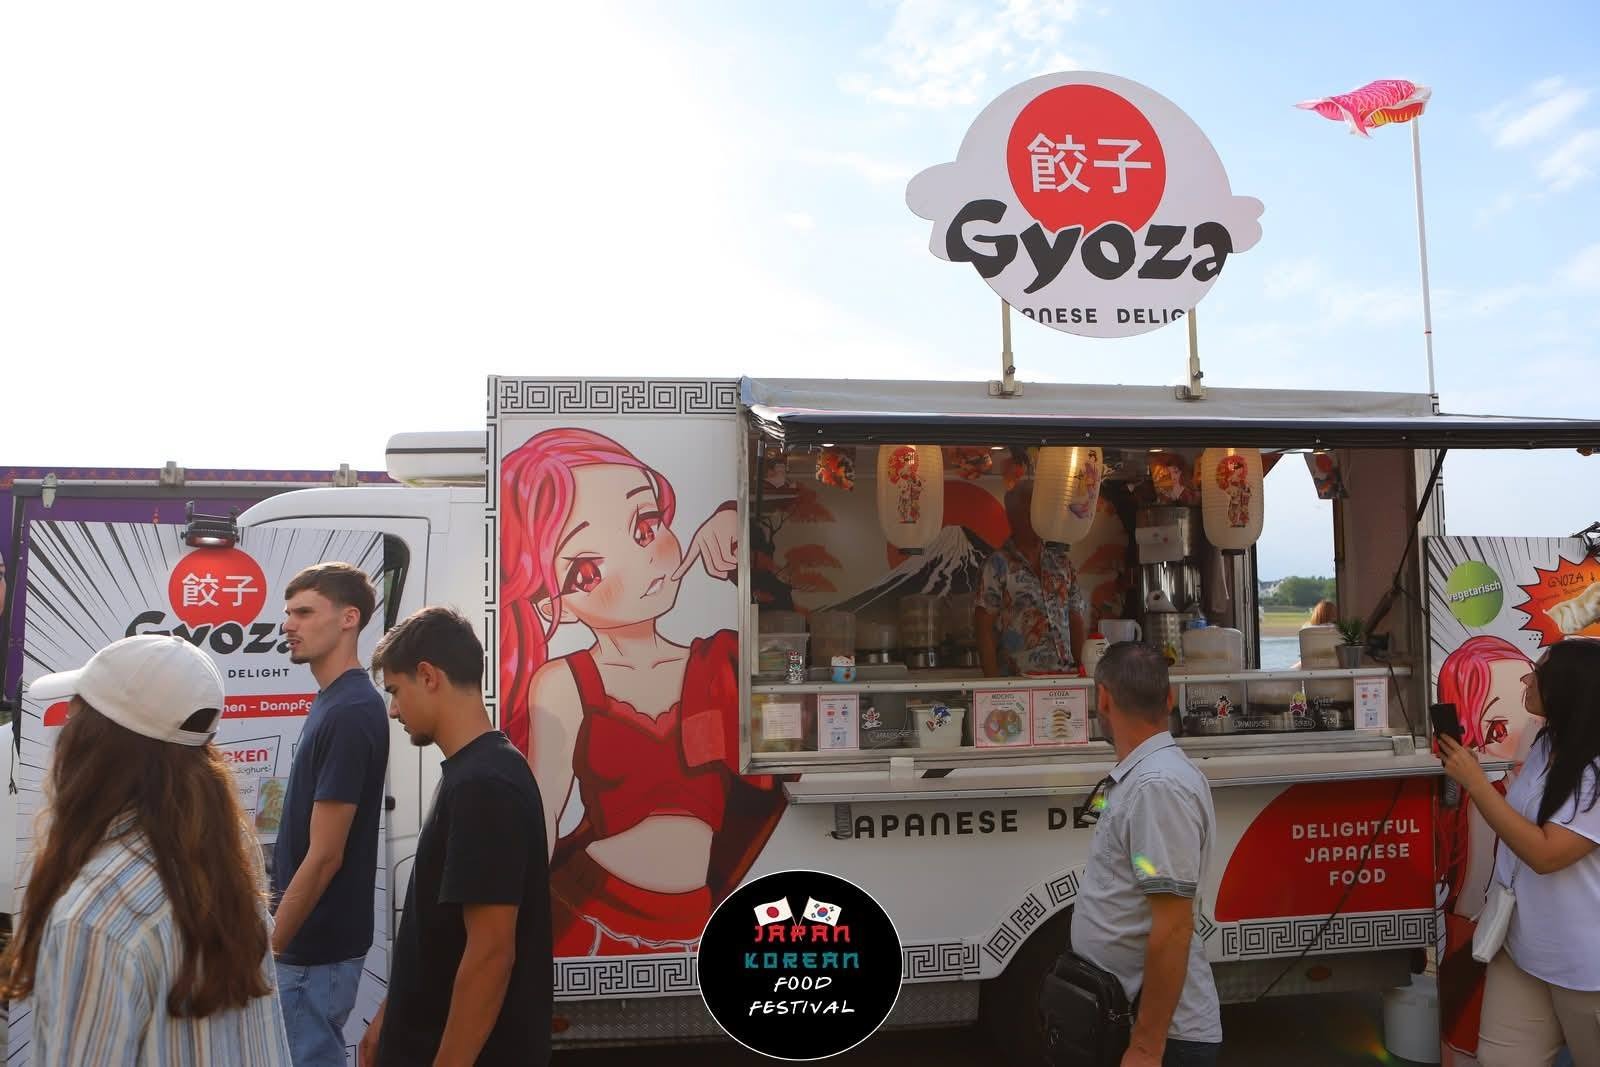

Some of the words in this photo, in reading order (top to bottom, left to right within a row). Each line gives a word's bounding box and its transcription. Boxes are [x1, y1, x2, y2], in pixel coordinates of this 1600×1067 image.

[1027, 132, 1152, 194] 餃子
[945, 199, 1234, 294] Gyoza
[181, 573, 259, 607] 餃子
[1448, 580, 1502, 602] vegetarisch
[228, 668, 290, 678] DELIGHT
[1292, 819, 1420, 840] DELIGHTFUL
[1304, 843, 1410, 863] JAPANESE
[1329, 868, 1387, 886] FOOD
